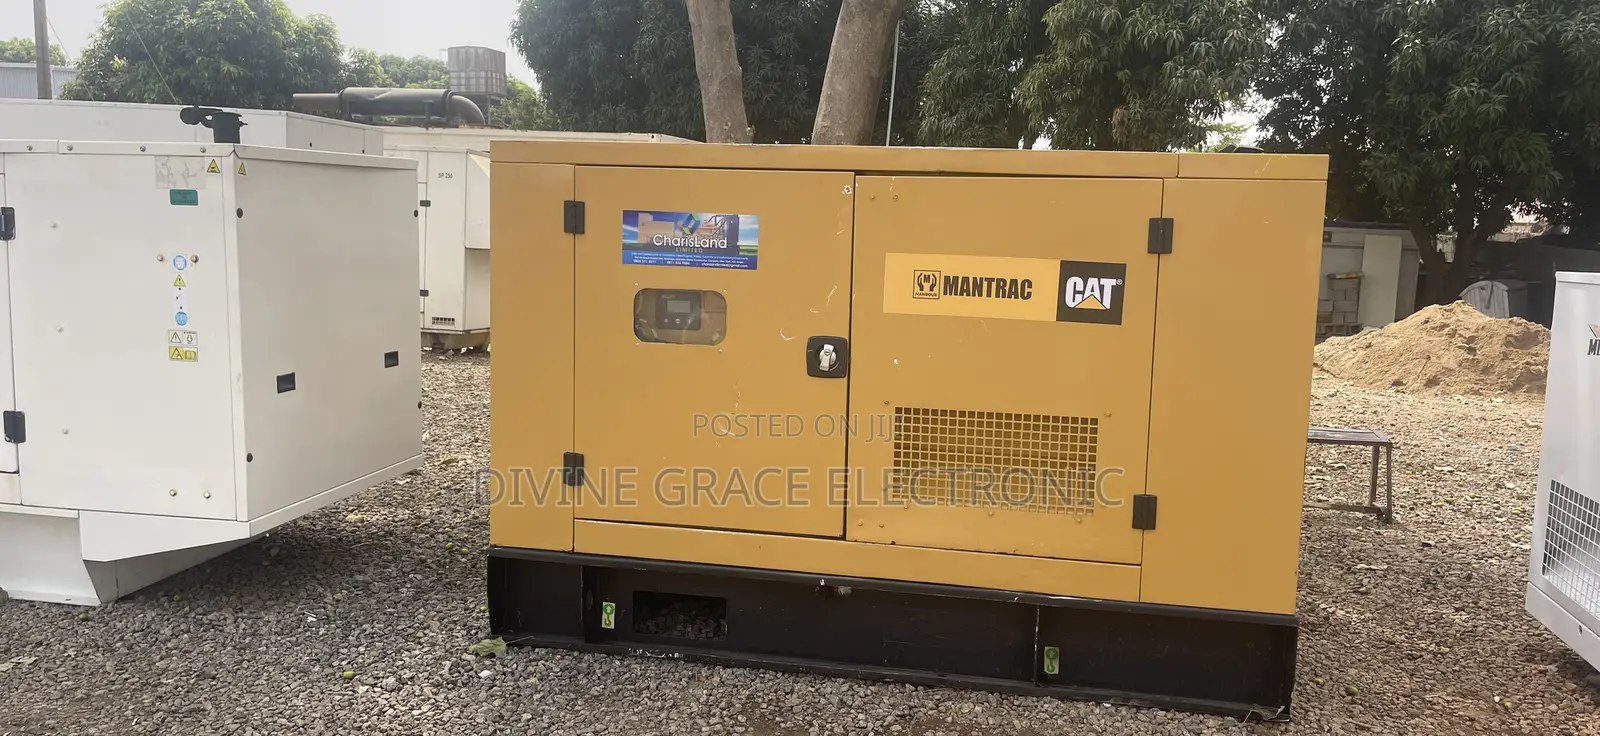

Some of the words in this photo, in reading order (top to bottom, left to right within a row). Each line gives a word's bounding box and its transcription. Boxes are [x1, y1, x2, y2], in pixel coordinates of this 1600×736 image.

[652, 234, 728, 249] CharisLand
[943, 275, 1033, 301] MANTRAC
[1065, 276, 1117, 309] CAT
